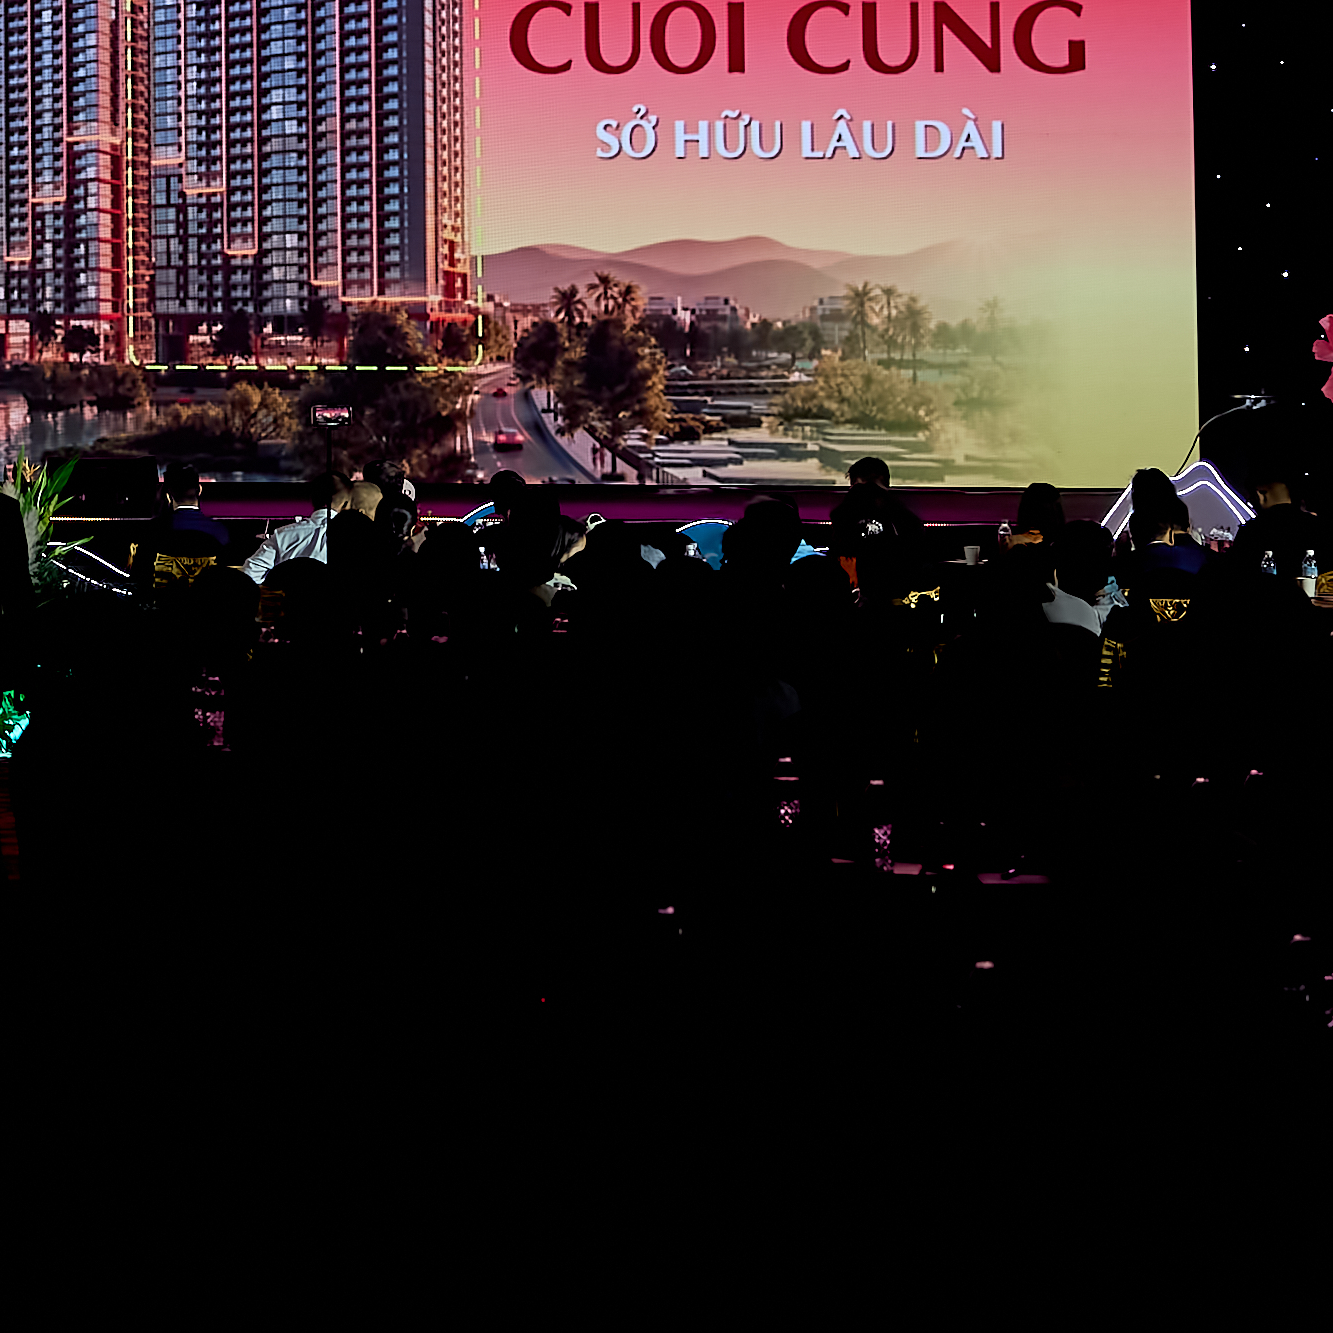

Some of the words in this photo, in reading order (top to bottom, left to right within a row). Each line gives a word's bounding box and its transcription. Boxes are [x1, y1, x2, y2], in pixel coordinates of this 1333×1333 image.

[596, 105, 656, 157] SỞ
[675, 110, 780, 157] HỮU
[802, 109, 892, 157] LÂU
[915, 109, 1001, 157] DÀI
